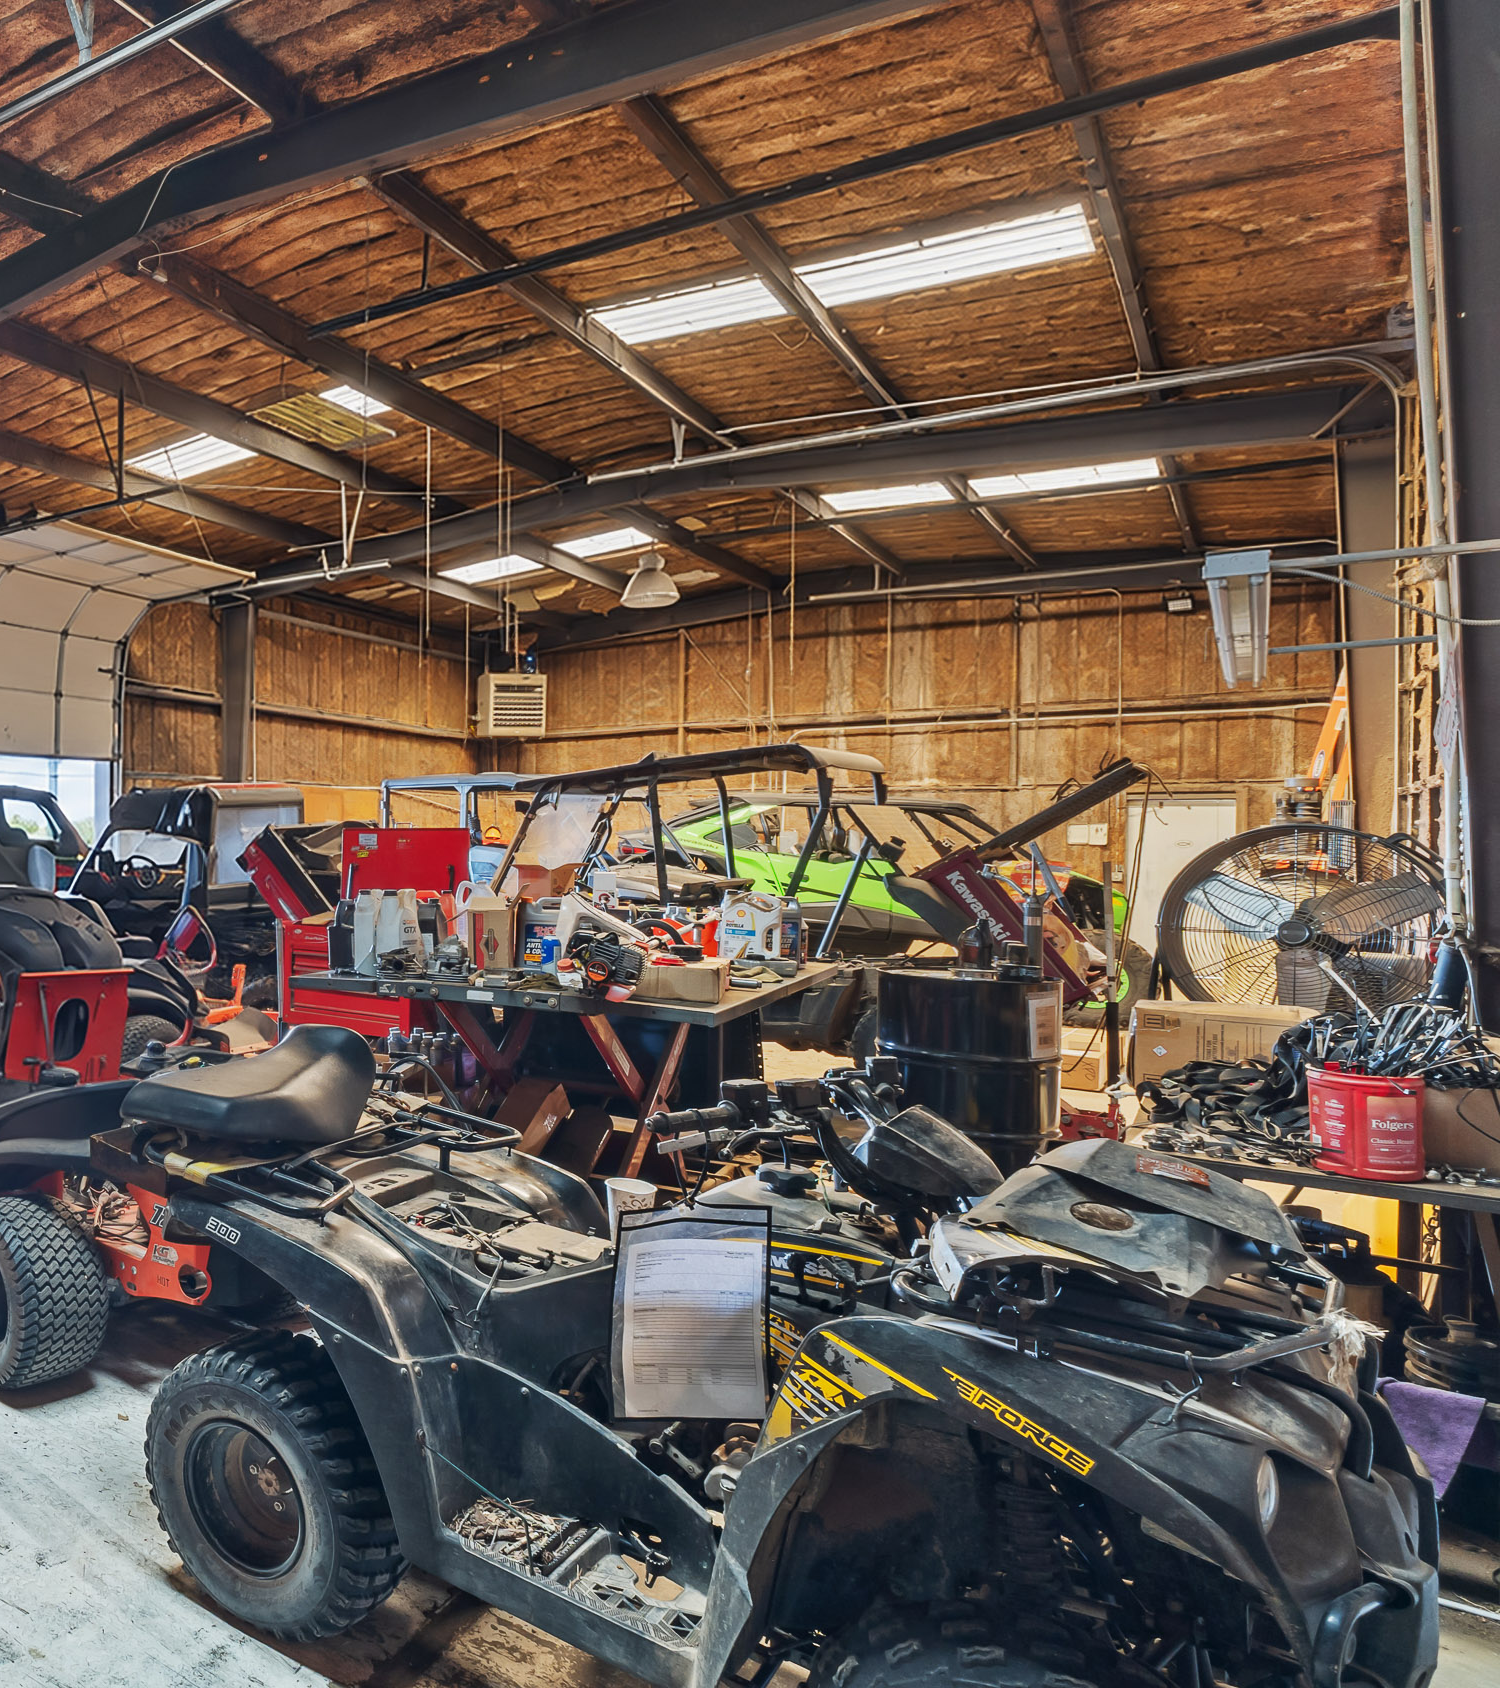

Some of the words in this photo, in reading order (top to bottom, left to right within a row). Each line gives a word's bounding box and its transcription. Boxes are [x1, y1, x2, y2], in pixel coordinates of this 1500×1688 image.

[945, 870, 1012, 942] Kawasaki
[403, 926, 417, 934] GTX
[1371, 1118, 1415, 1132] Folgers
[205, 1216, 241, 1245] 300
